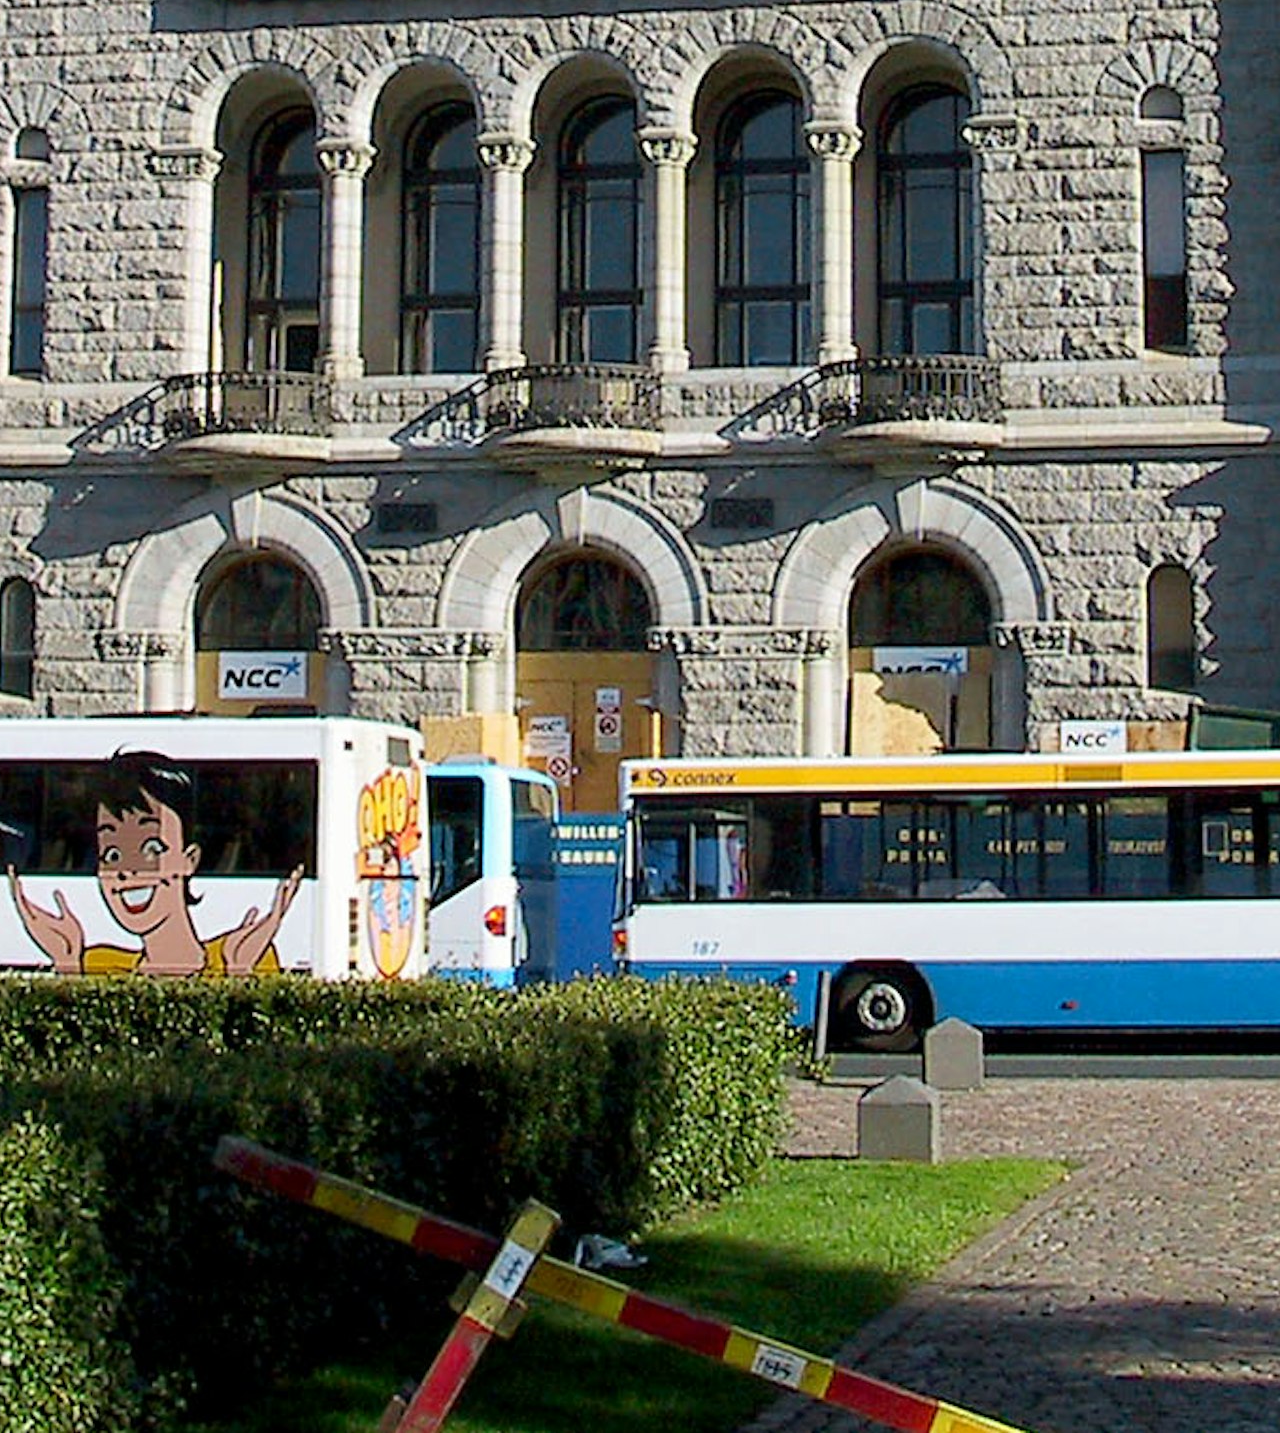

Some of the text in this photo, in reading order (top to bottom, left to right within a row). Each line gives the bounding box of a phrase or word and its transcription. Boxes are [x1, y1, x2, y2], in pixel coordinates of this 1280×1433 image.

[224, 668, 282, 688] NCC
[1066, 733, 1108, 747] NCC
[673, 772, 736, 785] connex
